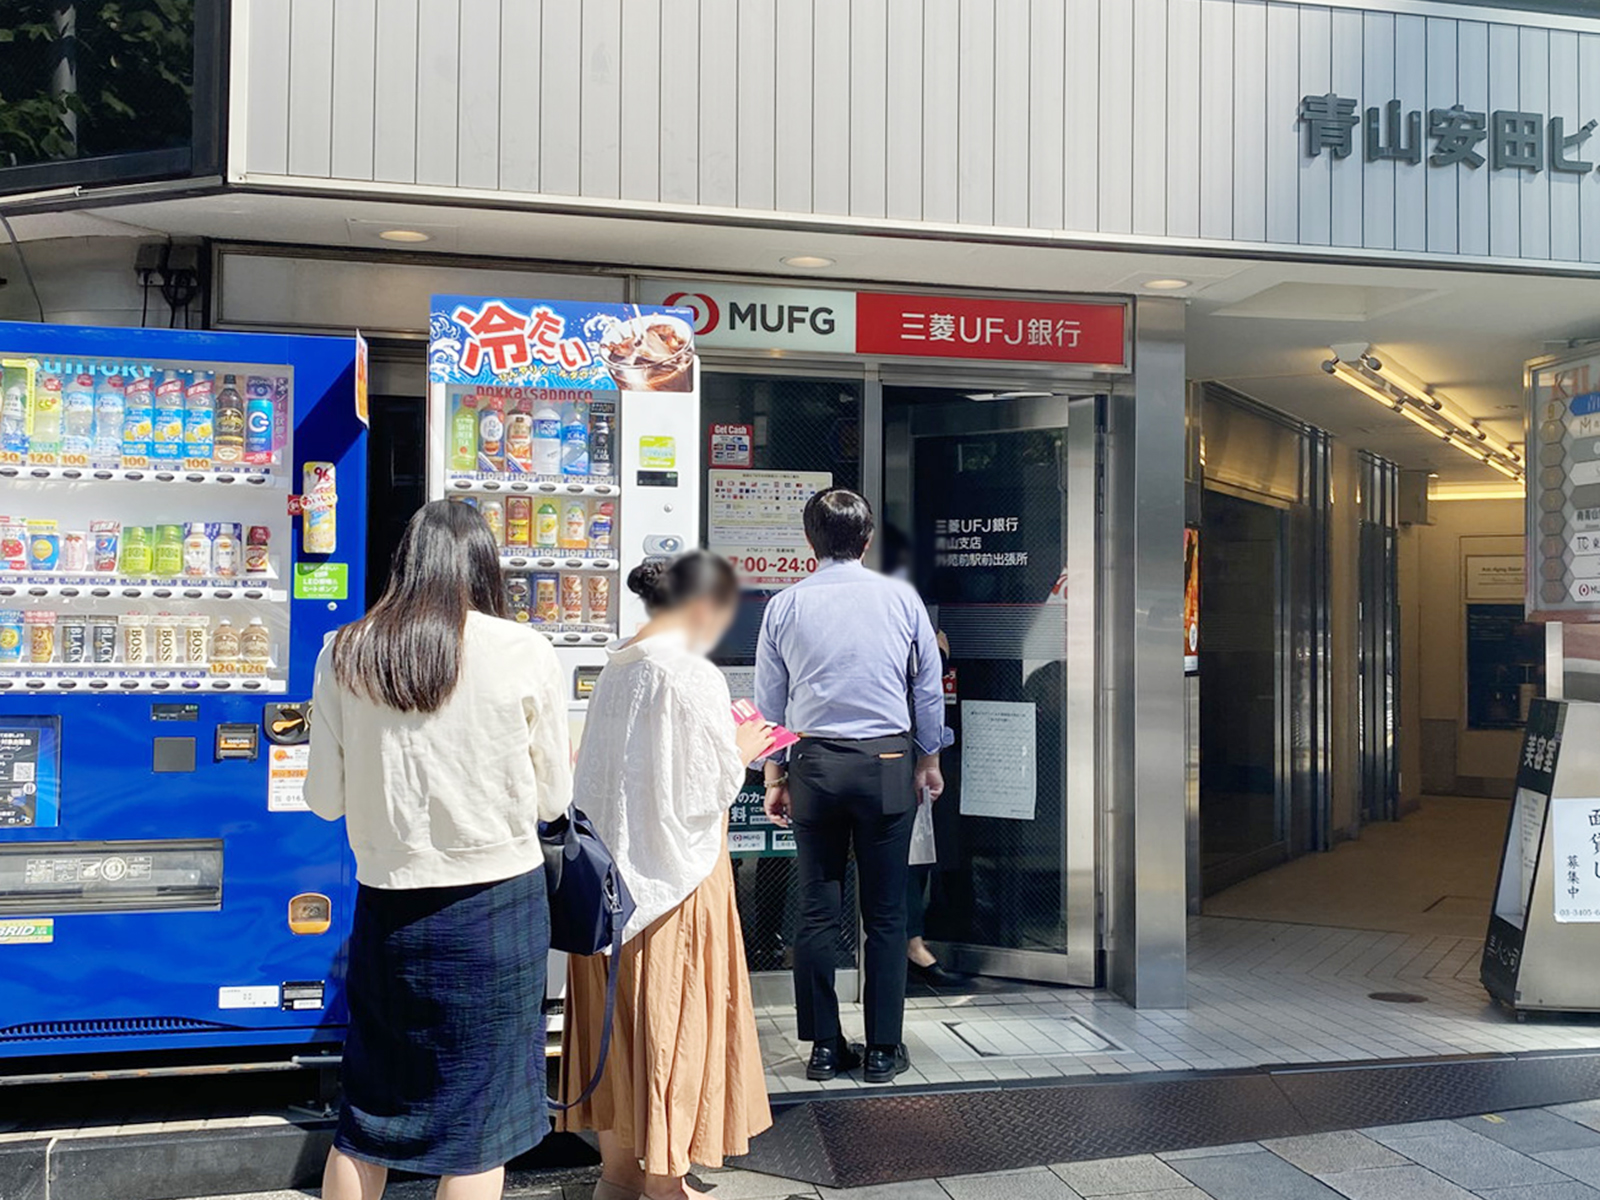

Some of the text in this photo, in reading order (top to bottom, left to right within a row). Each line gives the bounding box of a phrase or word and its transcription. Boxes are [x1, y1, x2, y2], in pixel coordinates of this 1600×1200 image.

[1299, 93, 1600, 174] 青山安田ビ
[729, 303, 835, 335] MUFG
[901, 312, 1081, 349] 三菱UFJ銀行
[714, 425, 748, 435] Get Cash
[29, 453, 54, 464] 120
[63, 455, 87, 465] 100
[123, 457, 147, 467] 100
[186, 459, 209, 469] 100
[936, 536, 982, 550] 山支店
[70, 626, 82, 663] BLACK
[101, 626, 113, 663] BLACK
[131, 629, 142, 662] BOSS
[161, 629, 172, 662] BOSS
[192, 629, 203, 662] BOSS
[211, 664, 234, 673] 120
[240, 664, 263, 673] 120
[1524, 733, 1556, 773] 美容室
[731, 805, 747, 822] 料
[1567, 854, 1580, 900] 募集中
